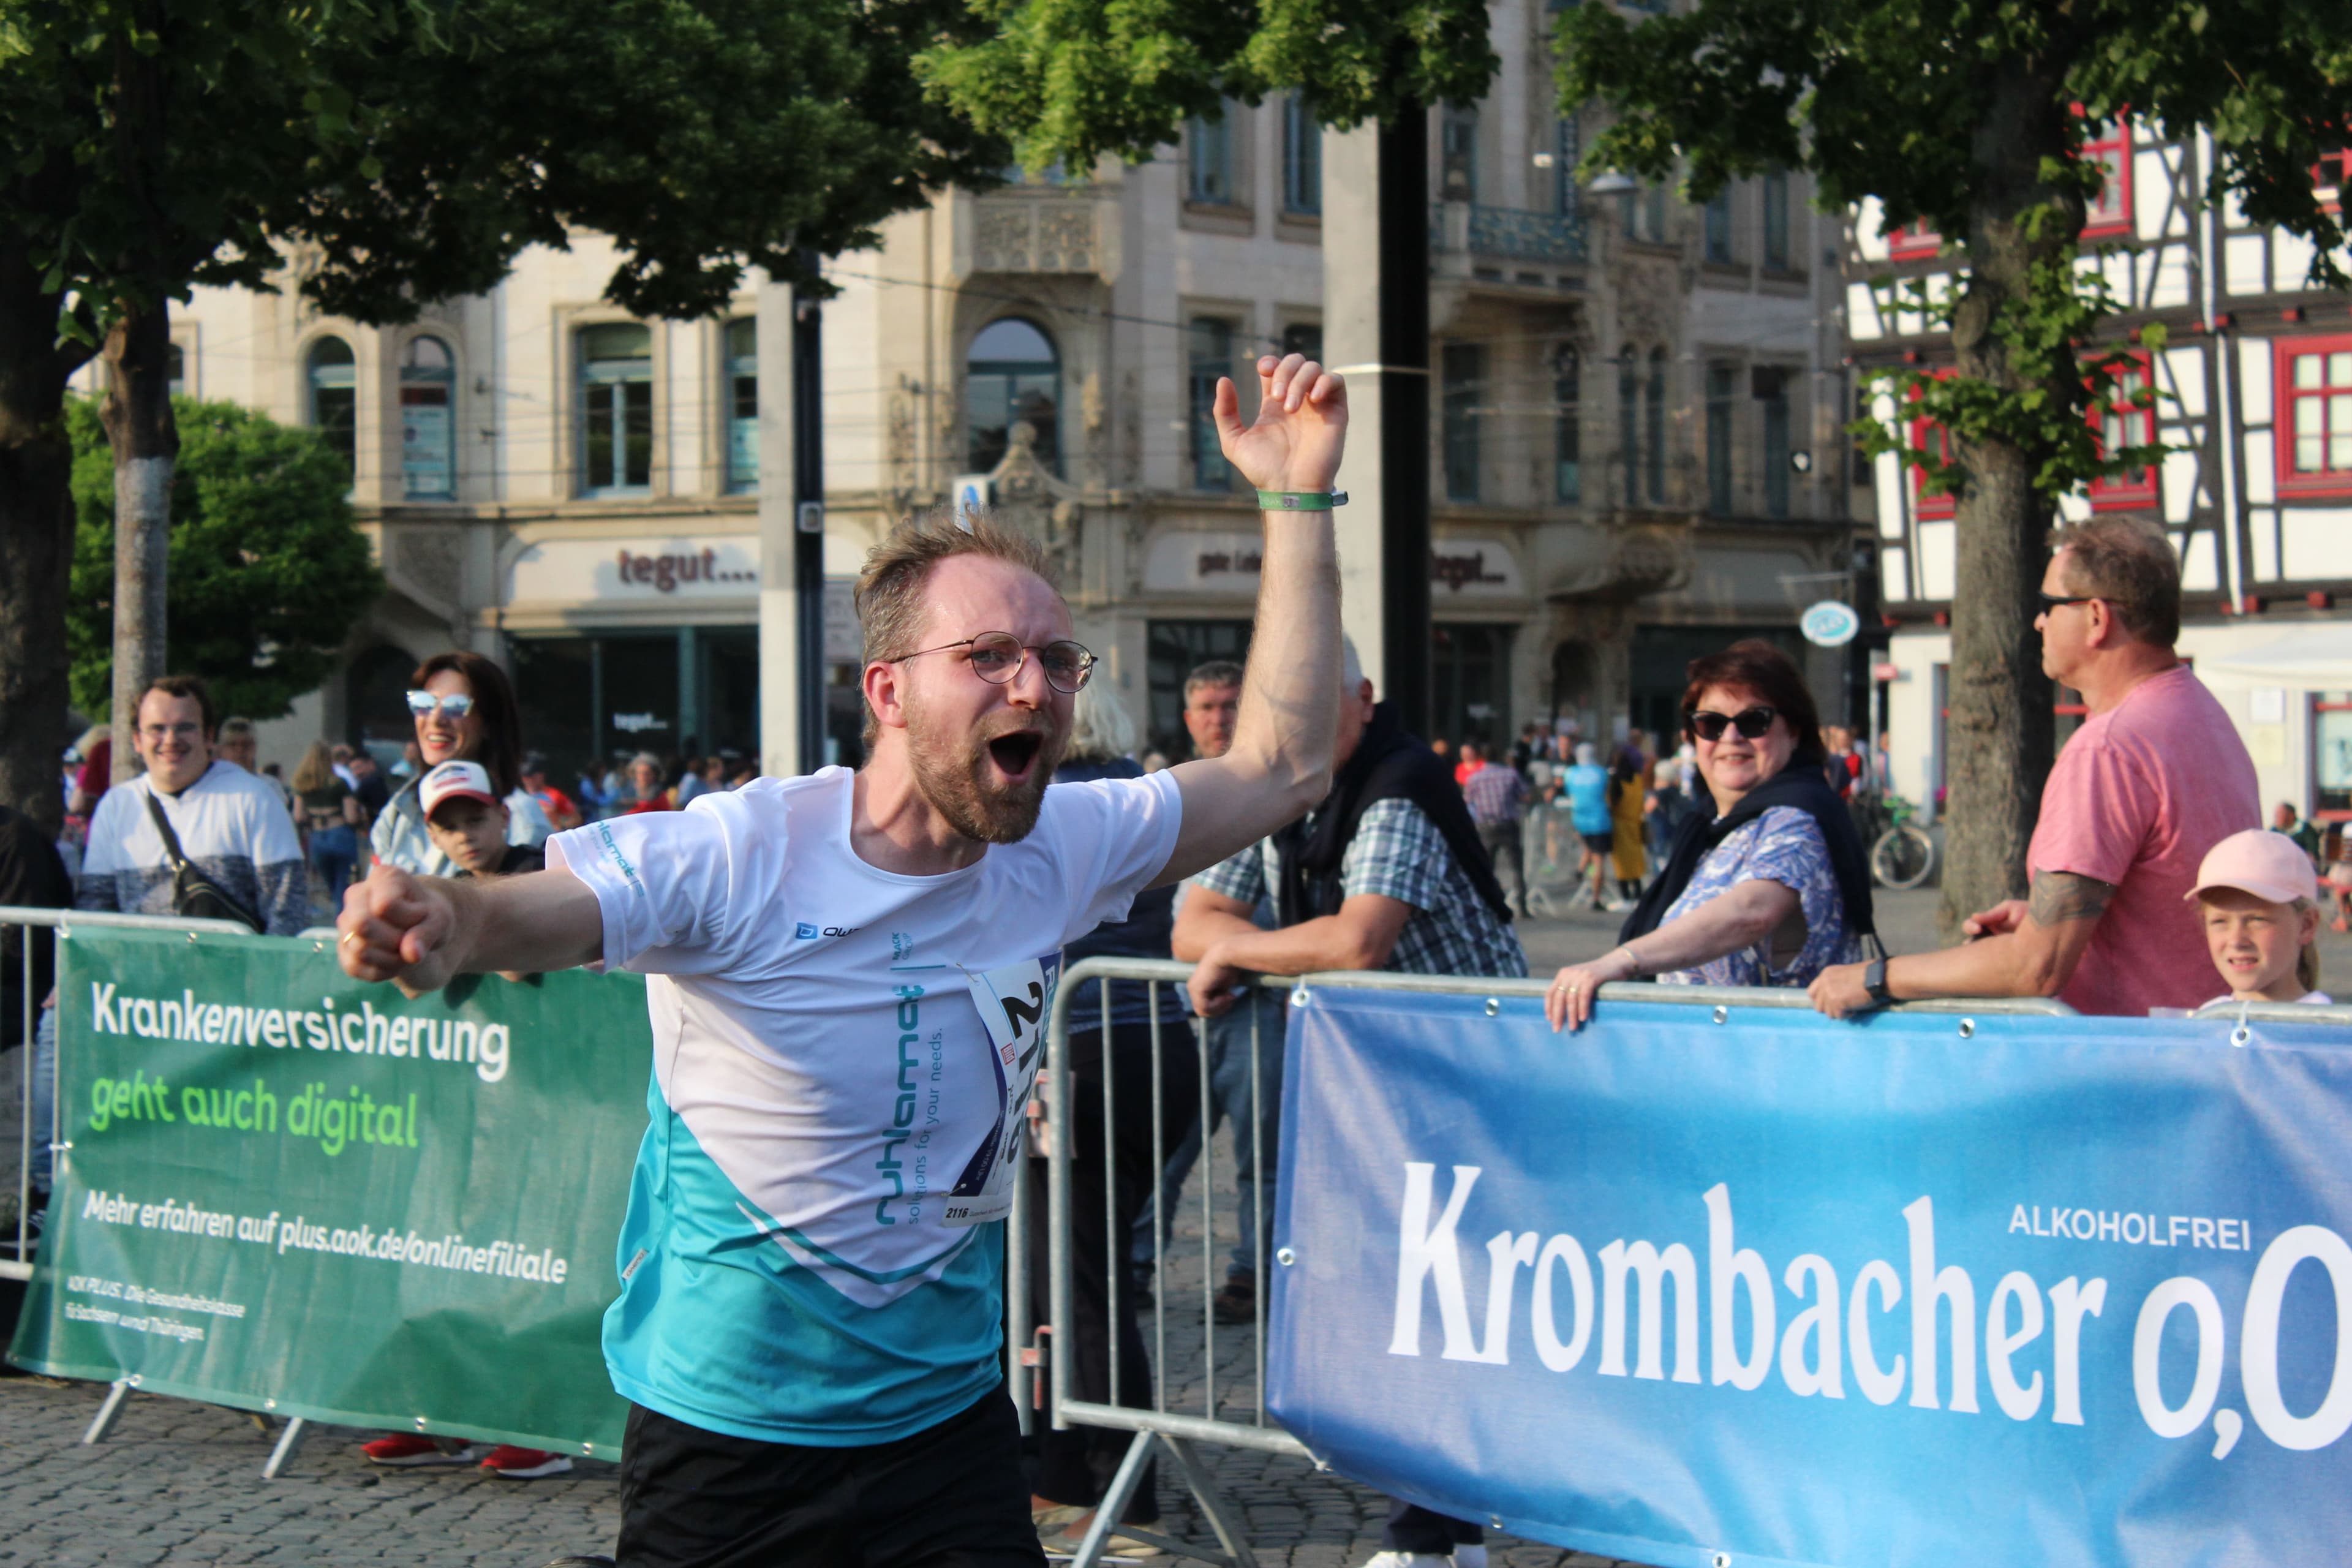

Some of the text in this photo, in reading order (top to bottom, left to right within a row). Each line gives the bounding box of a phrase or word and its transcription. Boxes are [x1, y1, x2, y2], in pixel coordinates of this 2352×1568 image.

[617, 547, 756, 593] tegut...
[892, 932, 902, 960] MACK
[91, 982, 510, 1082] Krankenversicherung
[92, 1071, 418, 1156] geht auch digital
[907, 1028, 943, 1224] solutions for your needs.
[83, 1189, 568, 1284] Mehr erfahren auf plus.aok.de/onlinefiliale
[946, 1207, 969, 1218] 2116
[2008, 1204, 2251, 1251] ALKOHOLFREI
[1387, 1161, 2108, 1427] Krombacher
